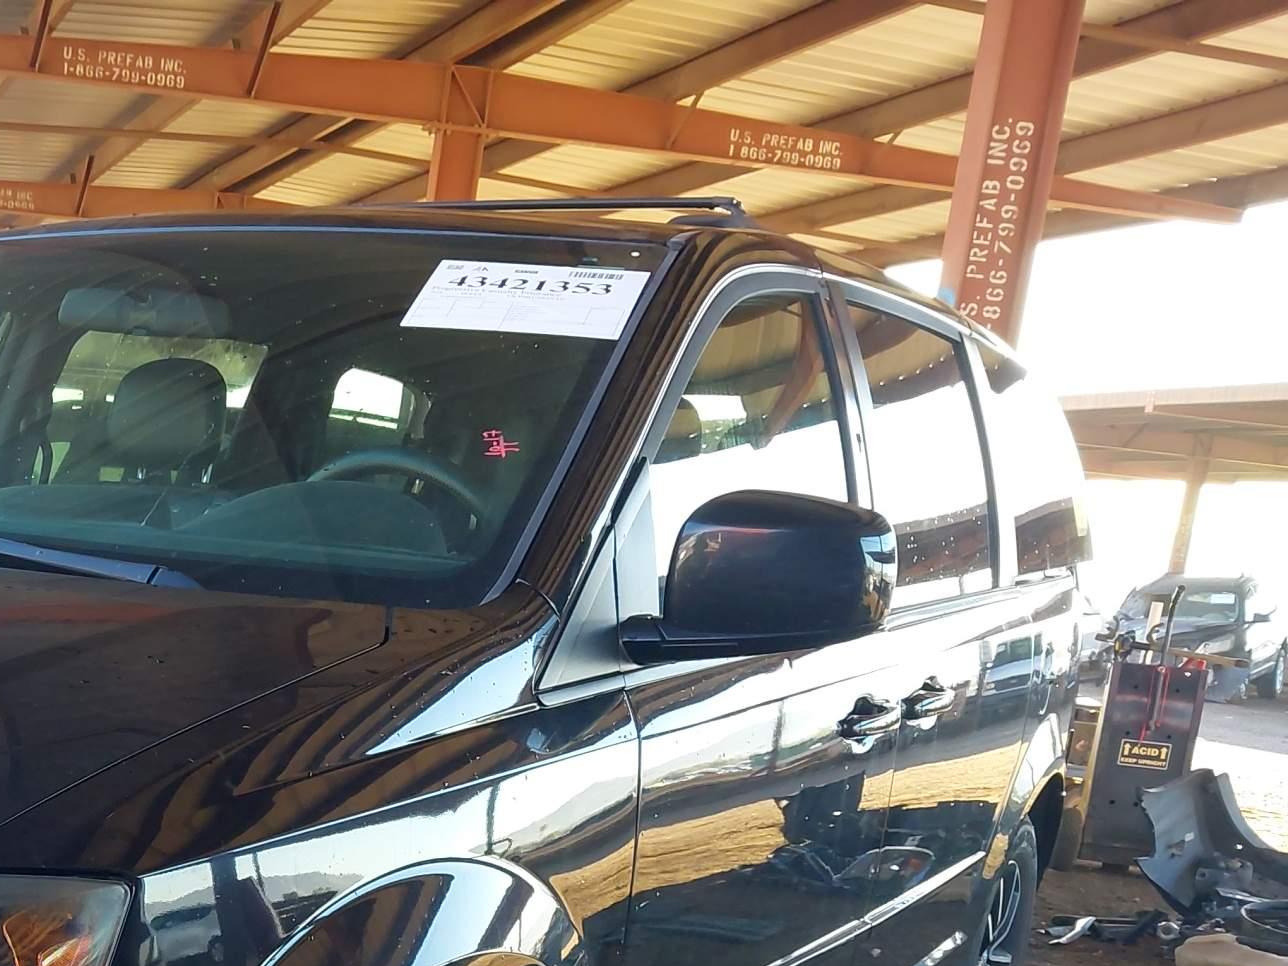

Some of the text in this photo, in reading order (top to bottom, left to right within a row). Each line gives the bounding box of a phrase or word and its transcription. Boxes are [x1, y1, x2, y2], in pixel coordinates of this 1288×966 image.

[63, 46, 187, 75] U.S. PREFAB INC.
[63, 61, 185, 89] 1-866-799-0969
[730, 128, 843, 156] U.S. PREFAB INC.
[966, 179, 1001, 279] PREFAB
[987, 117, 1013, 165] INC.
[983, 121, 1035, 330] -866-799-0969
[448, 275, 613, 296] 43421353
[1131, 746, 1160, 757] ACID
